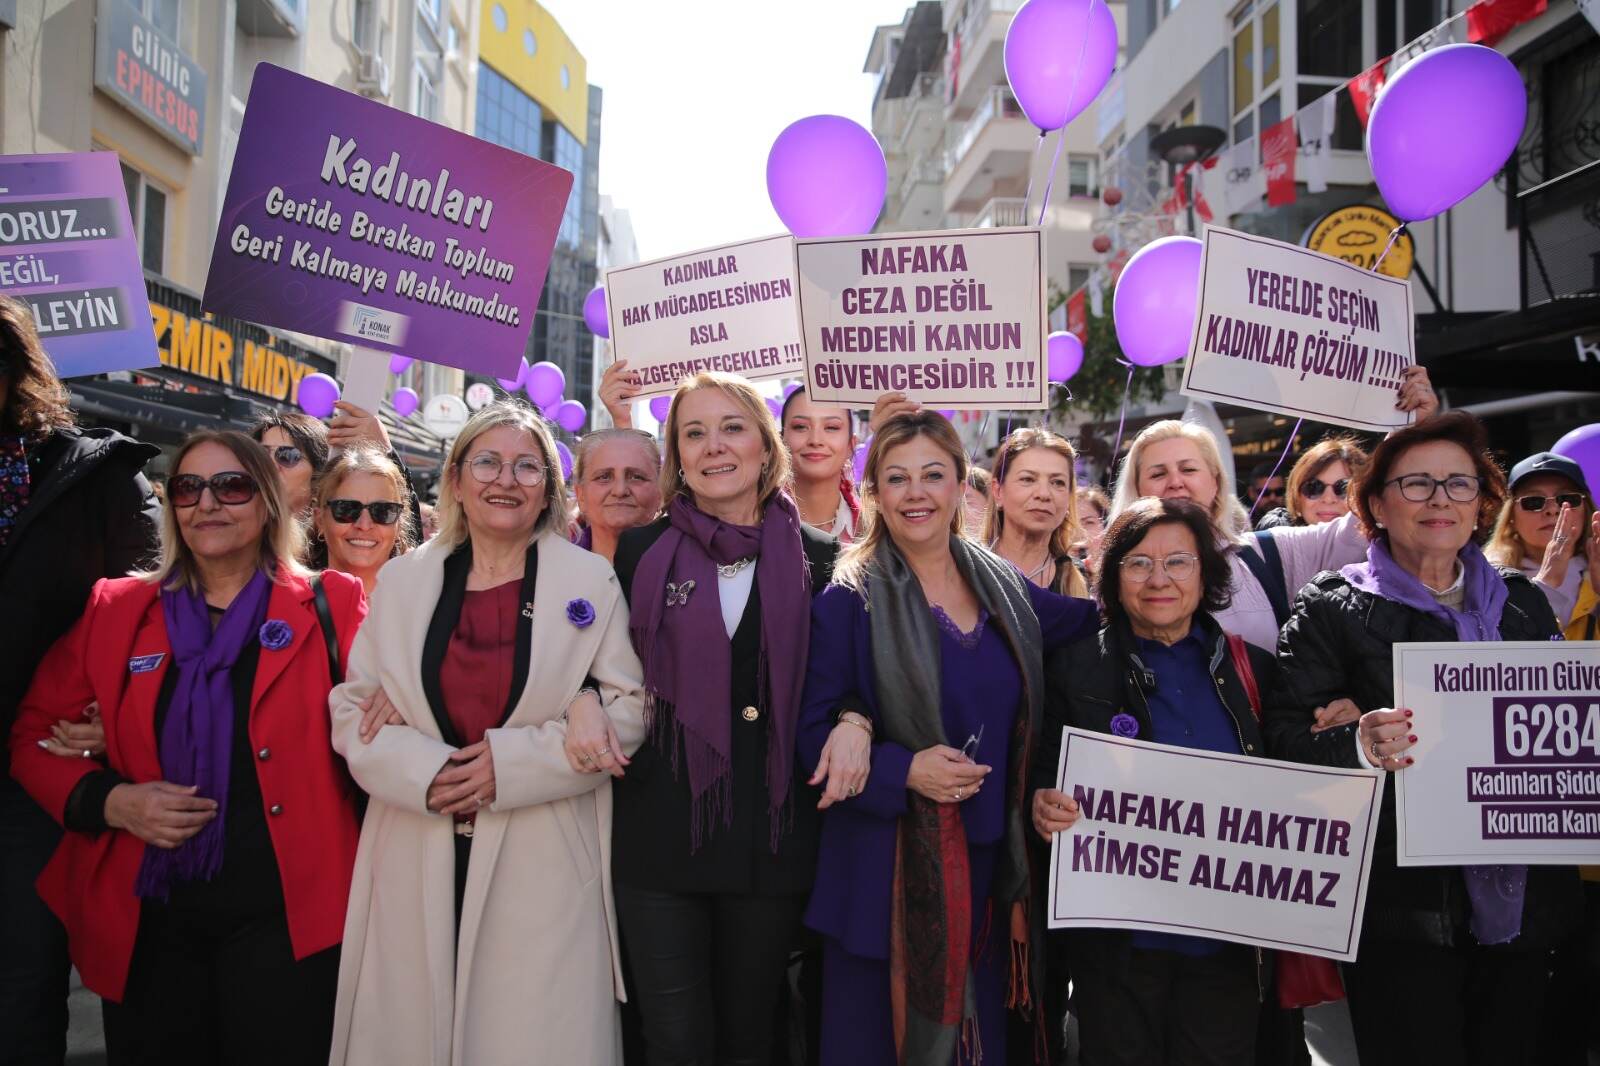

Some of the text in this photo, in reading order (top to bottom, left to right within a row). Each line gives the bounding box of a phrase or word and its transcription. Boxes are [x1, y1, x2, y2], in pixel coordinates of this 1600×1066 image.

[132, 25, 190, 97] clinic
[116, 48, 198, 143] EPHESUS
[320, 134, 493, 230] Kadınları
[265, 186, 515, 283] Geride Bırakan Toplum
[231, 224, 520, 326] Geri Kalmaya Mahkumdur.
[663, 255, 738, 287] KADINLAR
[861, 244, 968, 275] NAFAKA
[622, 278, 792, 327] HAK MÜCADELESİNDEN
[842, 278, 993, 315] CEZA DEĞİL
[1247, 268, 1380, 335] YERELDE SEÇİM
[368, 321, 391, 334] KONAK
[690, 322, 729, 346] ASLA
[821, 320, 1021, 352] MEDENİ KANUN
[1204, 314, 1299, 370] KADINLAR
[1300, 329, 1368, 383] ÇÖZÜM
[242, 335, 318, 405] MİDY
[784, 343, 802, 363] !!!
[814, 357, 1035, 390] GÜVENCESİDİR !!!
[1434, 663, 1548, 692] Kadınların
[1505, 704, 1600, 757] 6284
[1471, 771, 1553, 796] Kadınları
[1073, 784, 1351, 857] NAFAKA HAKTIR
[1487, 809, 1600, 834] Koruma Kan
[1072, 830, 1341, 908] KİMSE ALAMAZ
